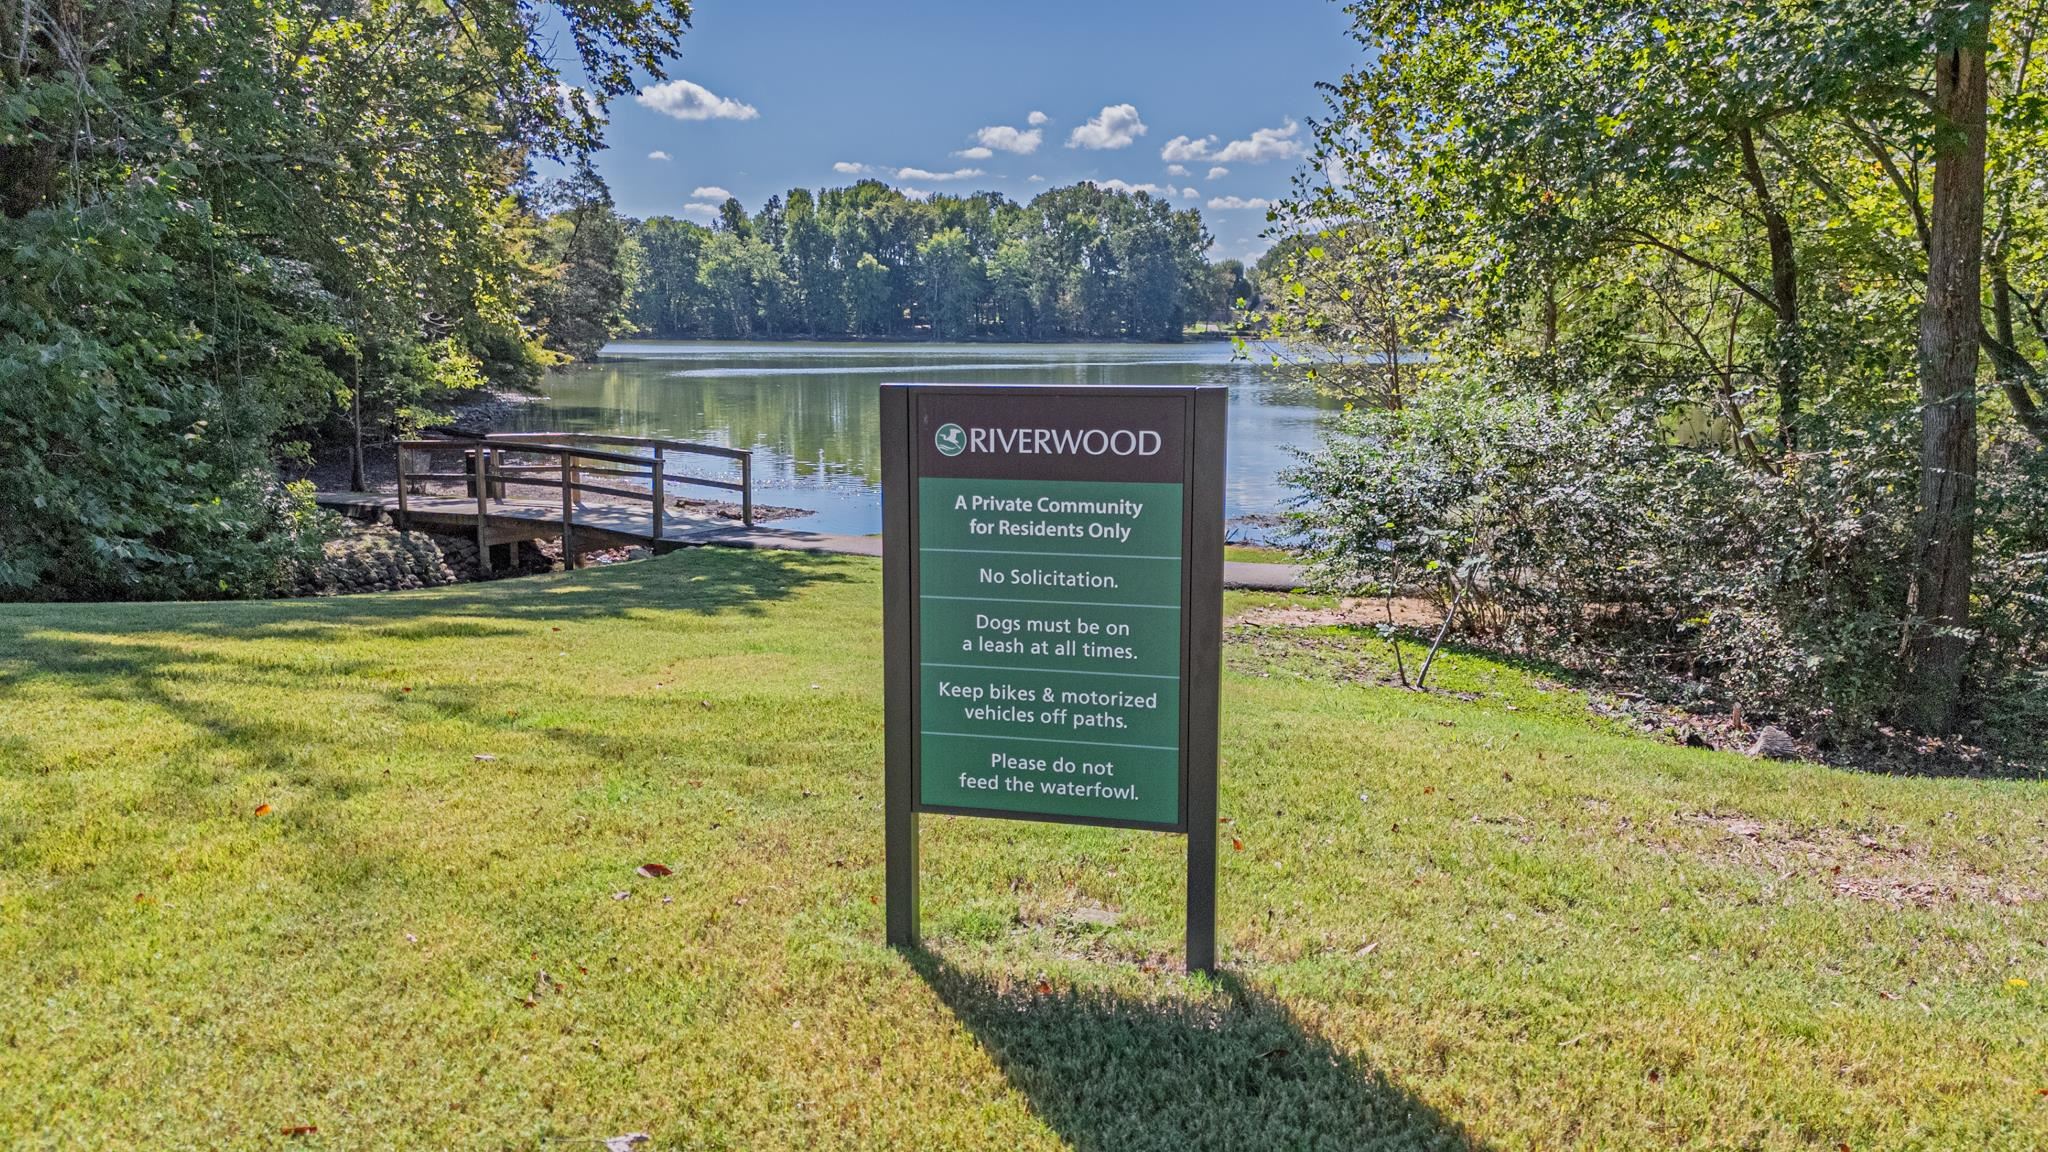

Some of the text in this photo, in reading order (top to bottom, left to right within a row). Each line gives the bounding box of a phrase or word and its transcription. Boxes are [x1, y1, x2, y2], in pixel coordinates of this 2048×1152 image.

[969, 428, 1162, 457] RIVERWOOD
[955, 494, 1144, 519] A Private Community
[970, 518, 1132, 543] for Residents Only
[980, 568, 1119, 589] No Solicitation.
[976, 614, 1130, 636] Dogs must be on
[962, 636, 1138, 660] a leash at all times.
[939, 681, 1157, 709] Keep bikes & motorized
[964, 704, 1128, 729] vehicles off paths.
[991, 753, 1114, 776] Please do not
[959, 772, 1139, 801] feed the waterfowl.
